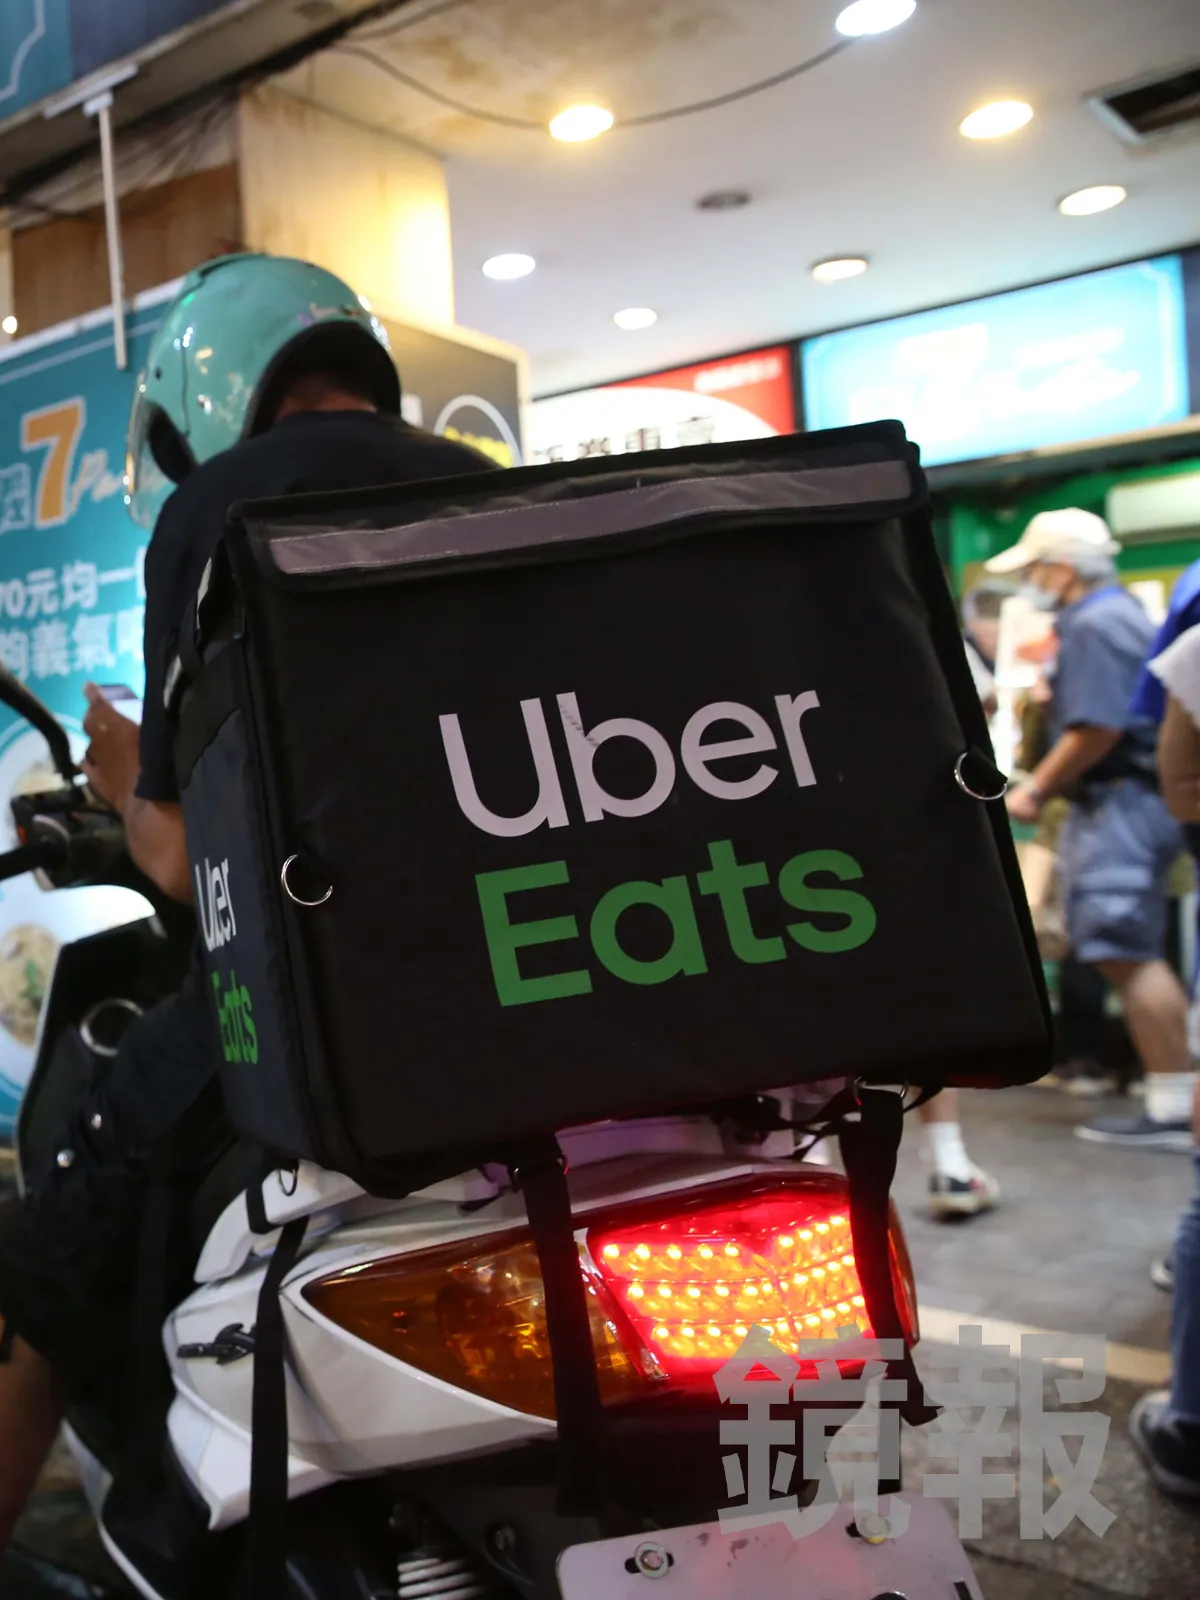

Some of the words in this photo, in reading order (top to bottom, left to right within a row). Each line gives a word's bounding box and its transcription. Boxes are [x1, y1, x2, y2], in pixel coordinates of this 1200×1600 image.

[20, 396, 87, 530] 7
[438, 690, 820, 838] Uber
[475, 840, 877, 1007] Eats
